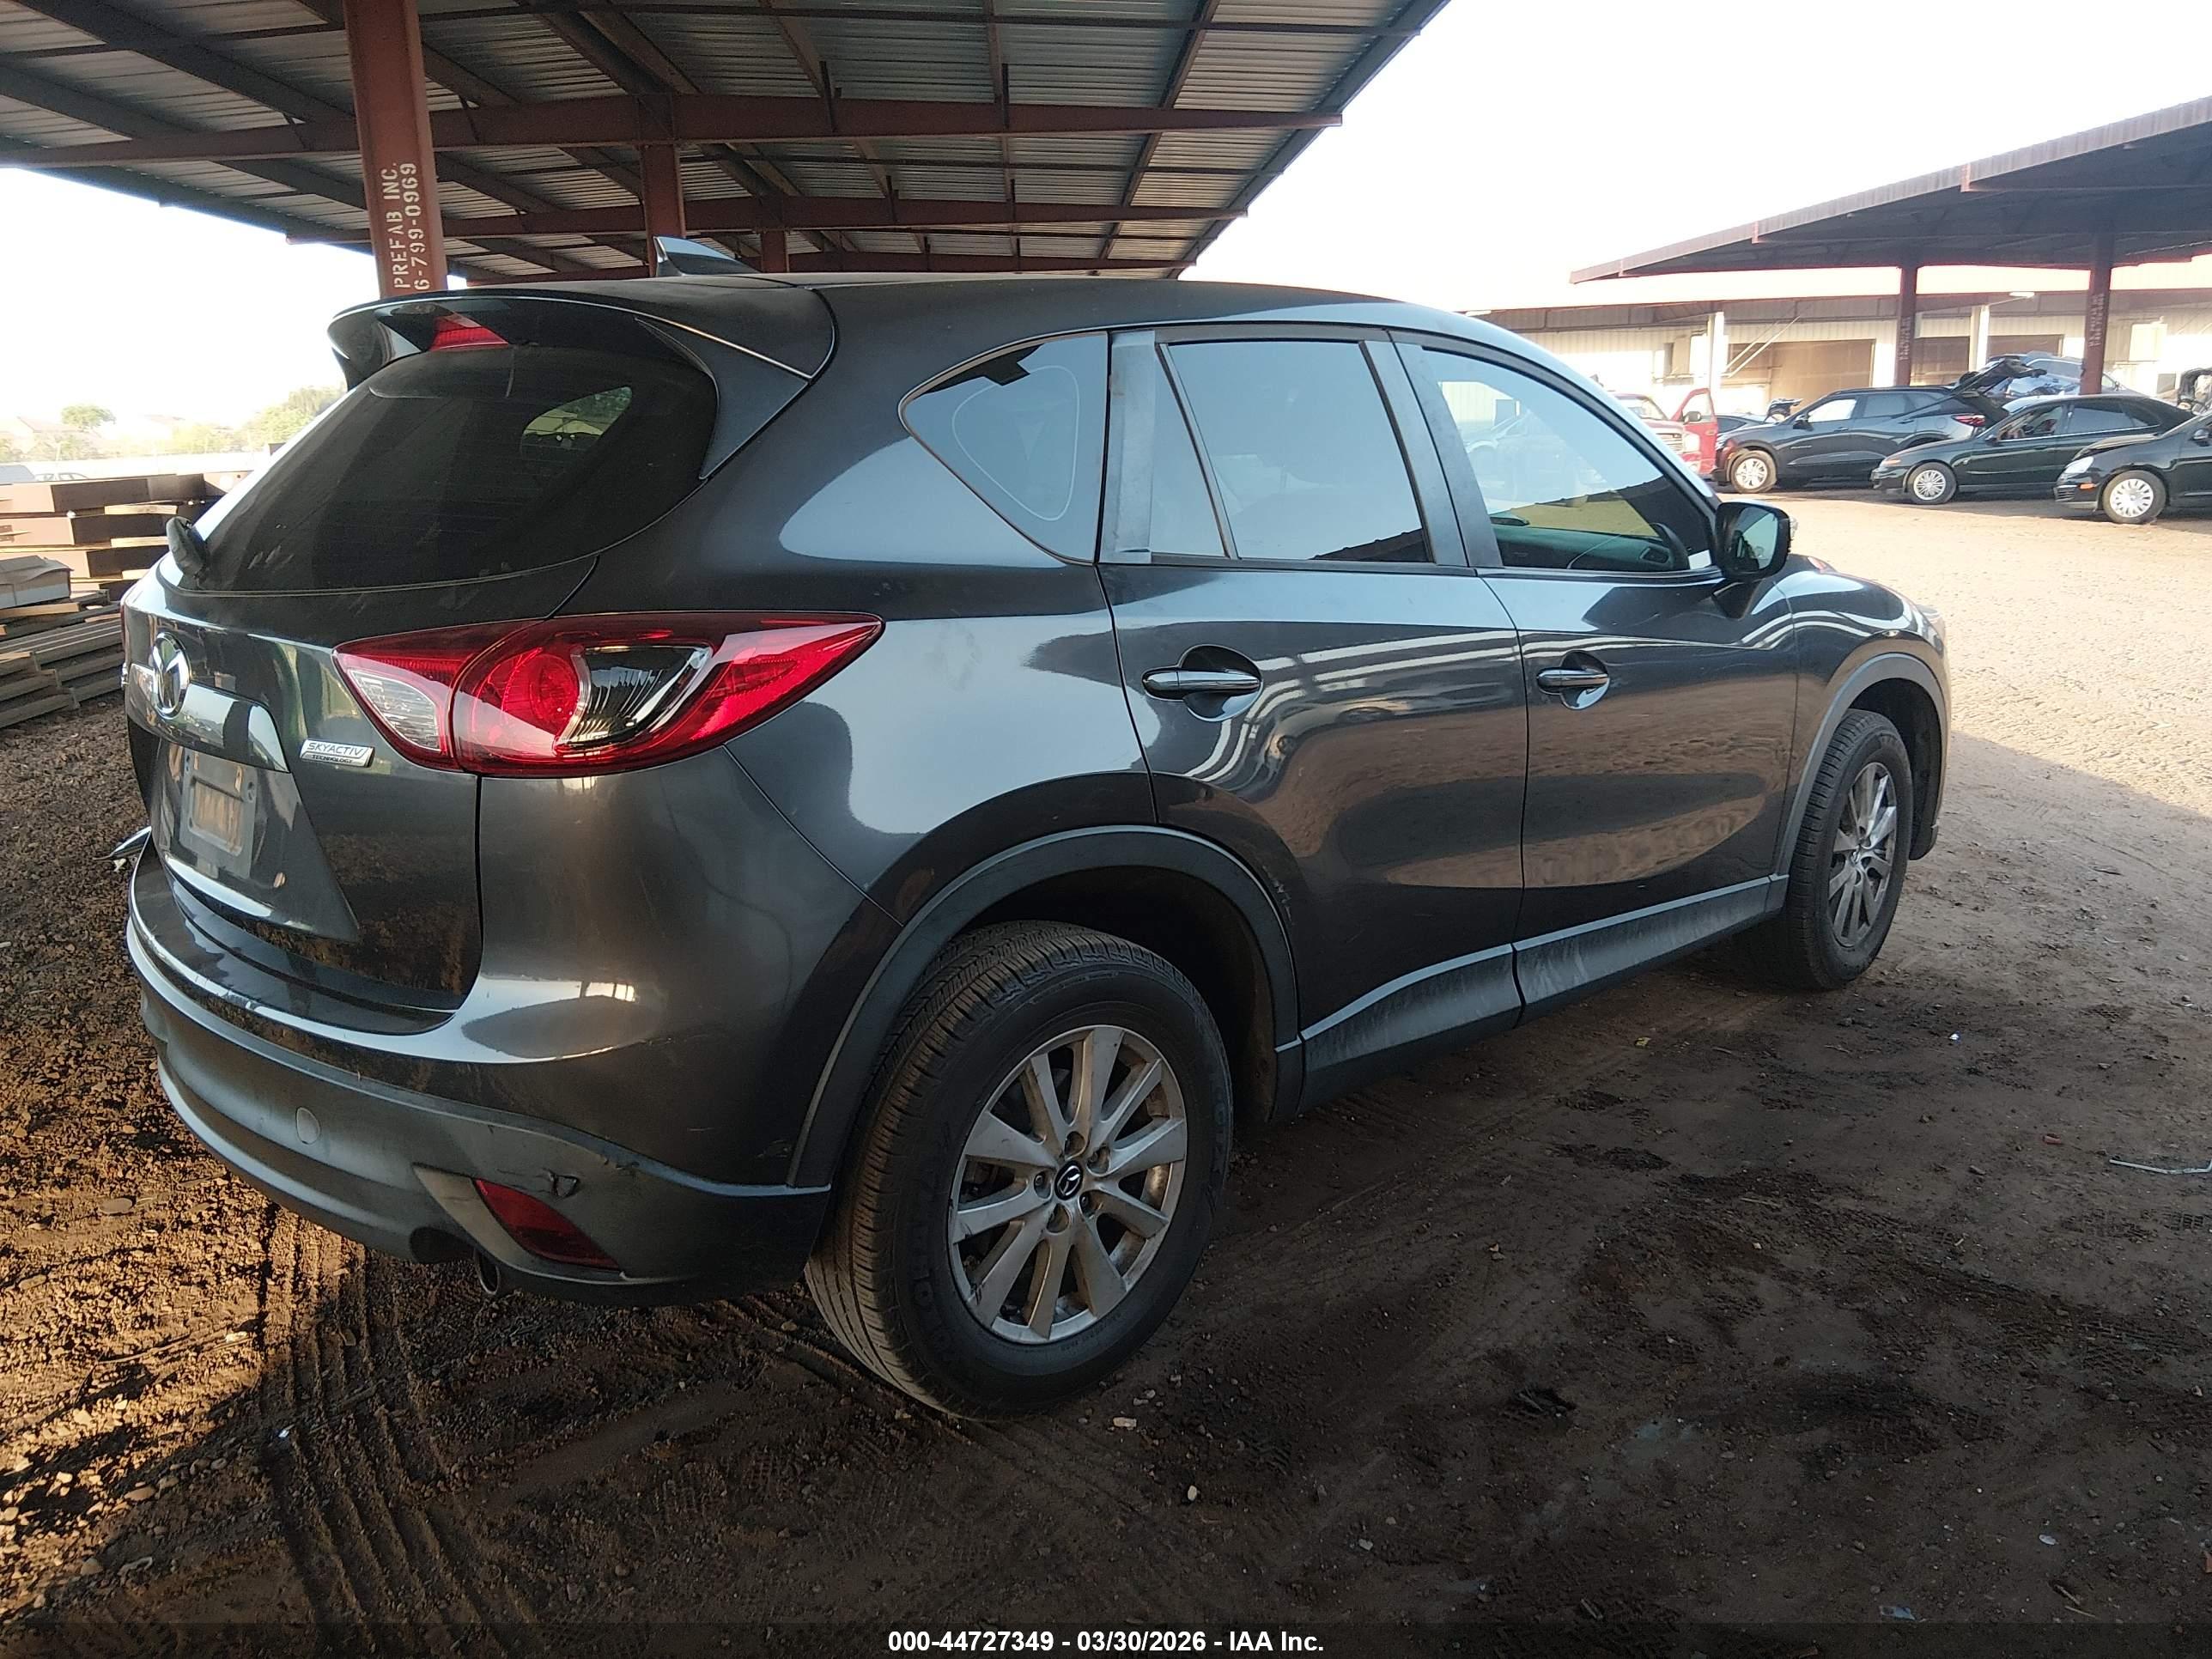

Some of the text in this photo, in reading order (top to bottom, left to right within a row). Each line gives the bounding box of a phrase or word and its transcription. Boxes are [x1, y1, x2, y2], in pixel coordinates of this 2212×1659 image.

[381, 162, 410, 289] PREFAB INC.
[399, 163, 430, 290] 6-799-0969
[307, 742, 364, 756] SKYACTIV
[311, 754, 354, 763] TECHNOLOGY
